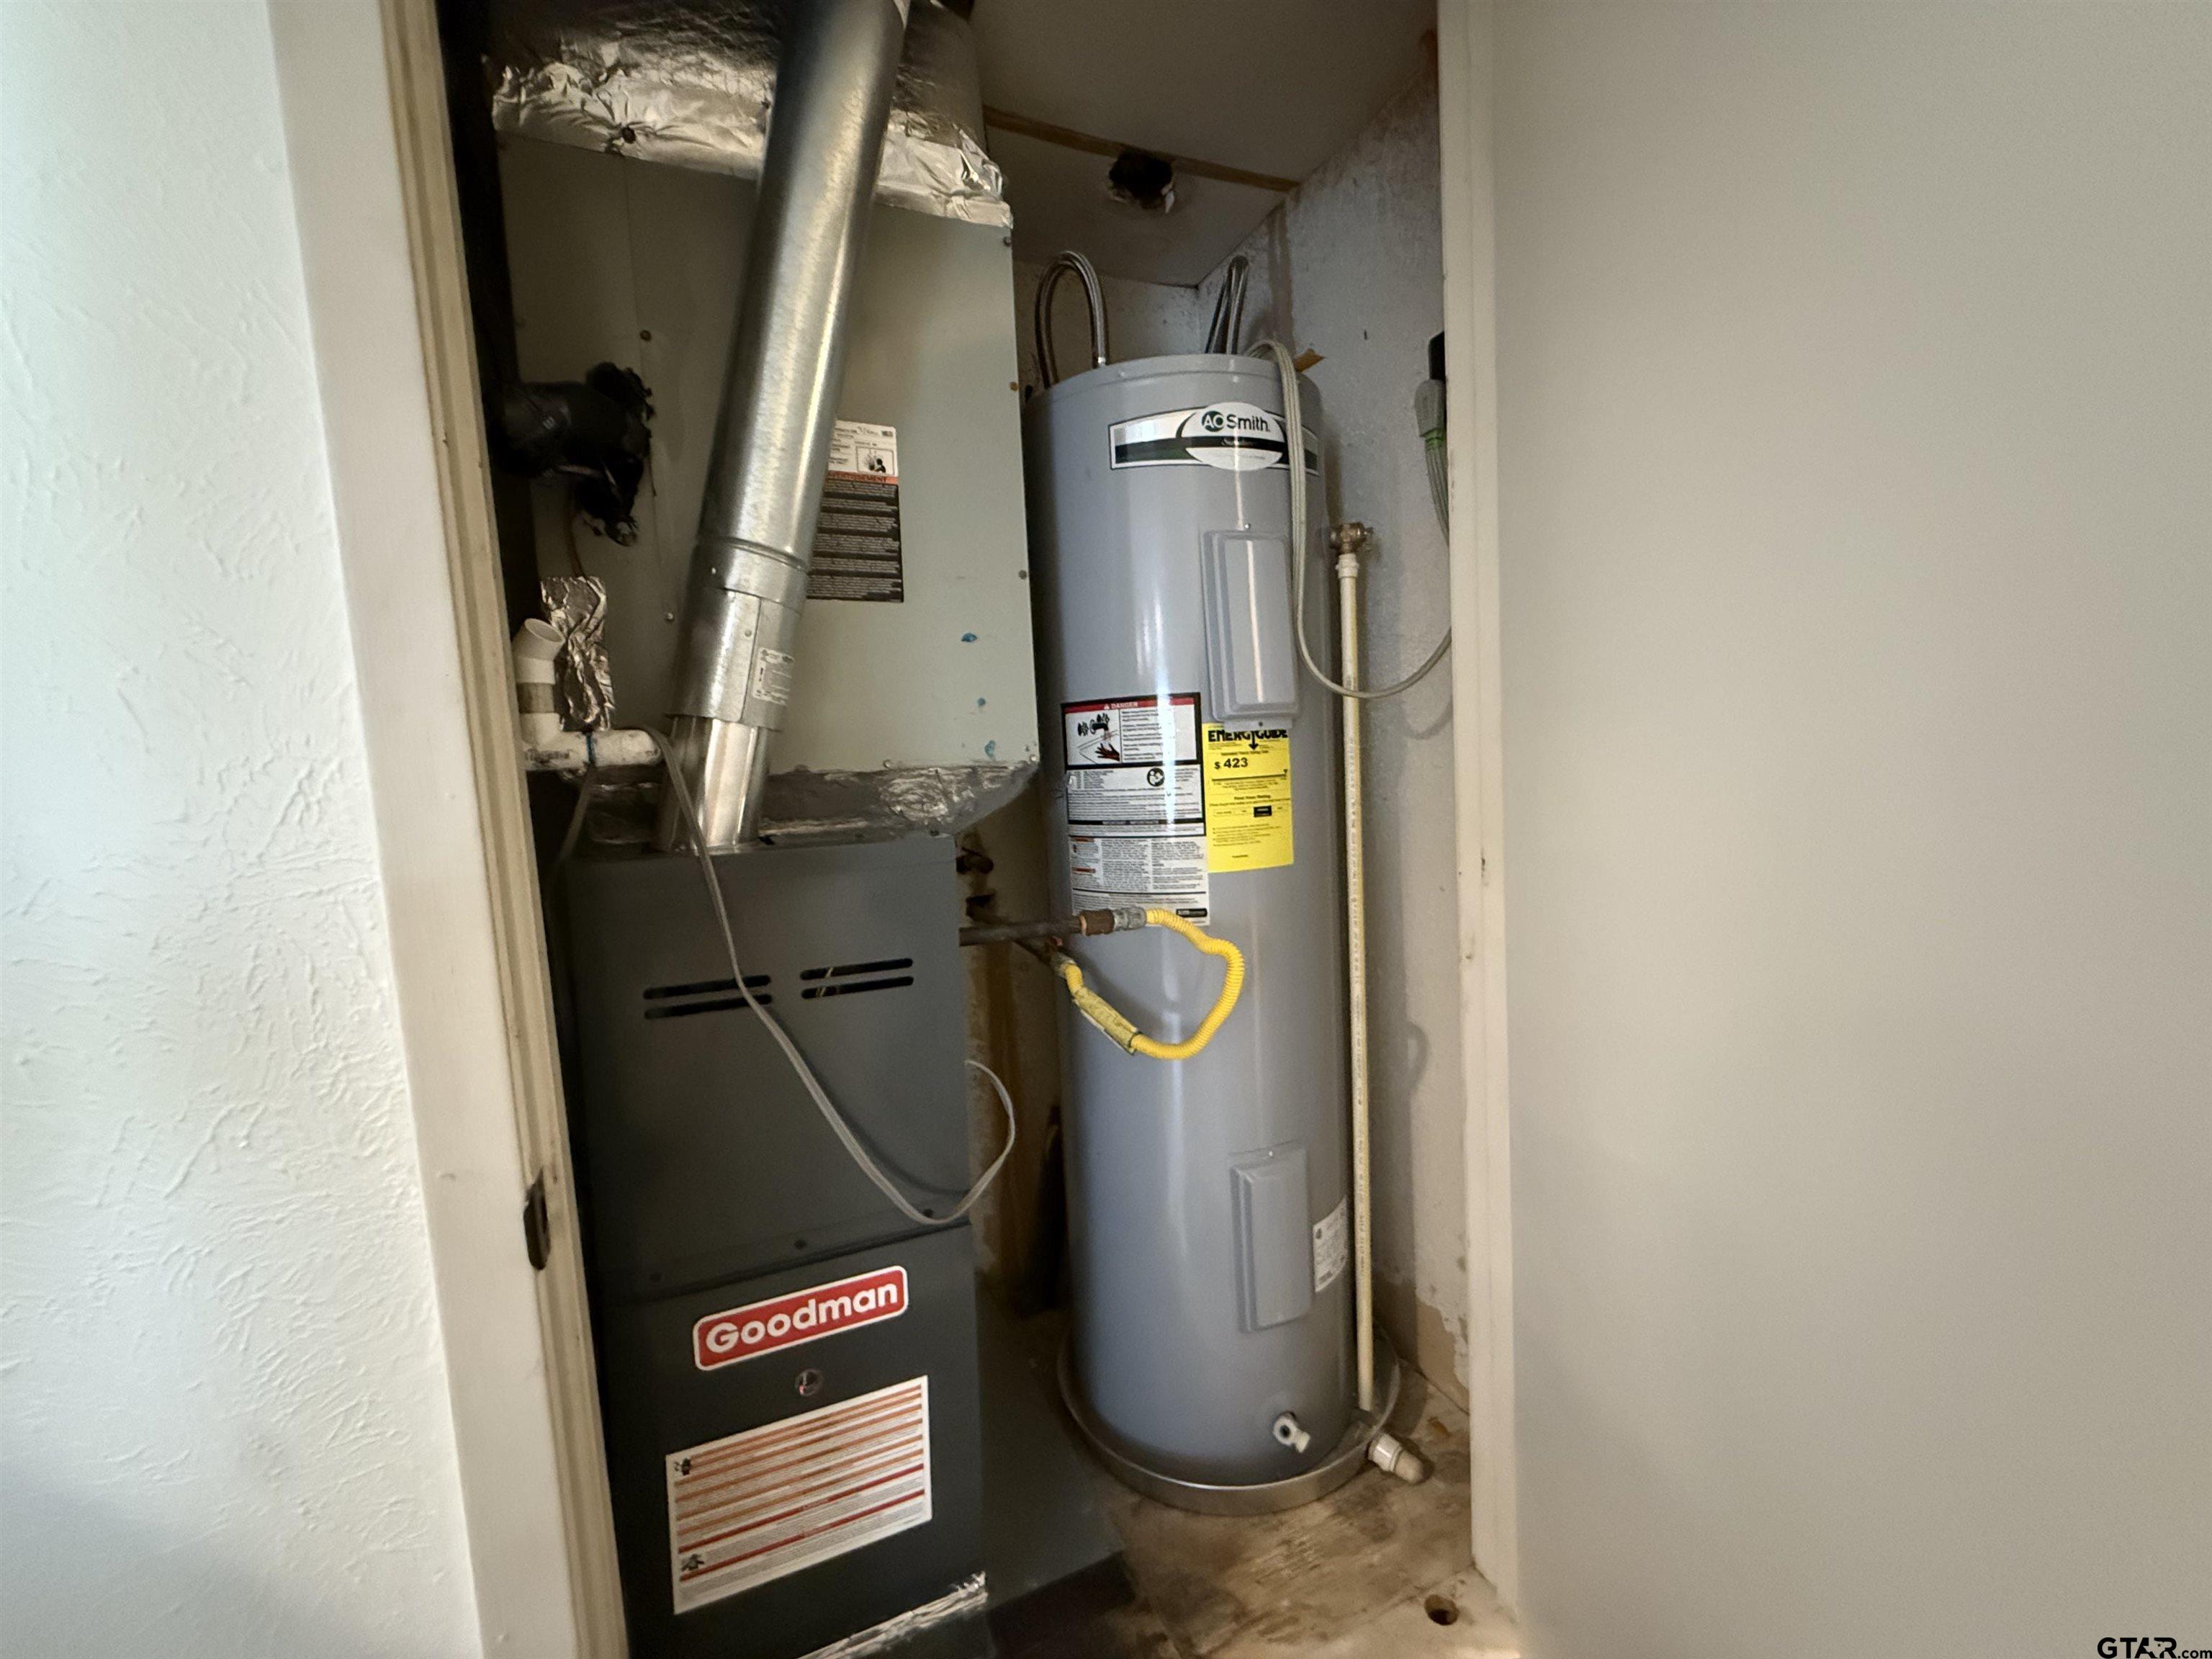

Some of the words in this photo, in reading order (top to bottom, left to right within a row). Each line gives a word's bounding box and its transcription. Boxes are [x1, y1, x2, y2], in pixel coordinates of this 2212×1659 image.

[1226, 414, 1269, 432] Smith
[1111, 701, 1138, 710] DANGER
[1215, 761, 1221, 770] $
[1224, 757, 1249, 768] 423
[706, 1282, 898, 1354] Goodman
